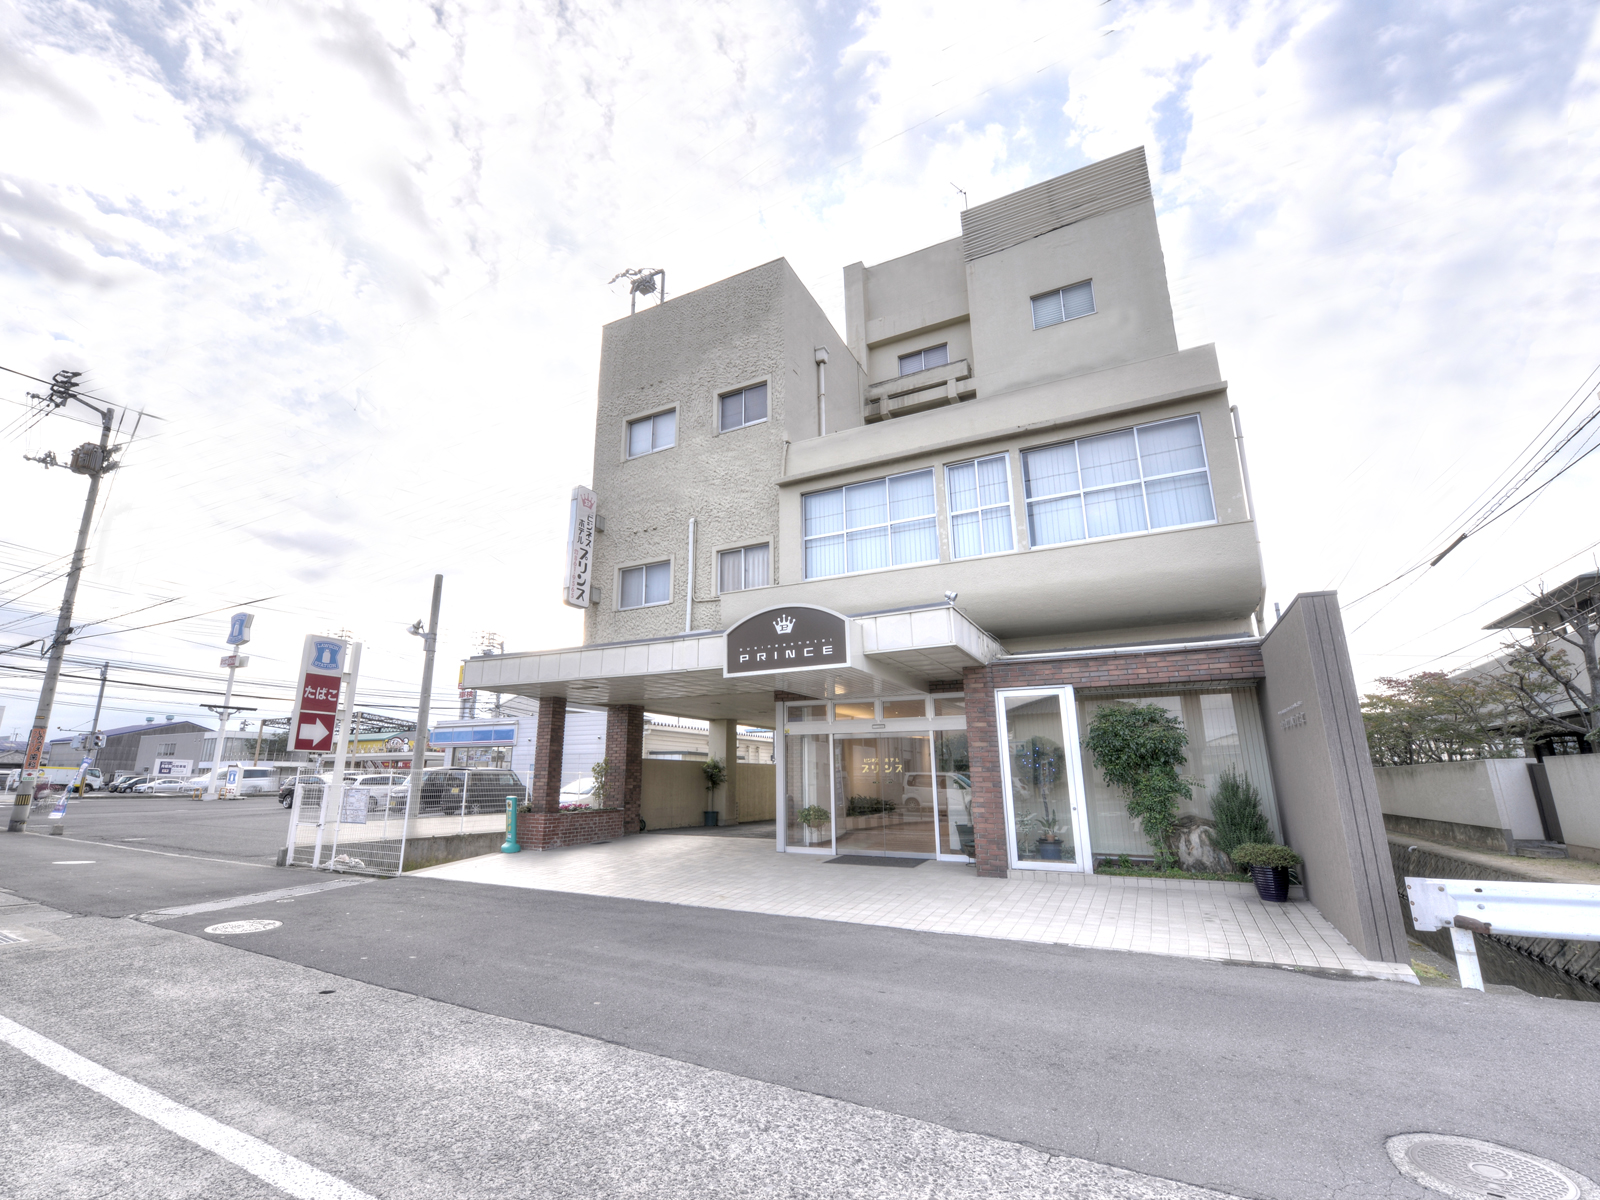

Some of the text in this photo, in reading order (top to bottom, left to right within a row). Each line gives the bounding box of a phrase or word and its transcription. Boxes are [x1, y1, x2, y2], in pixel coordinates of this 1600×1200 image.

[575, 547, 589, 602] プリンス
[739, 645, 833, 663] PRINCE
[304, 685, 337, 701] たばこ
